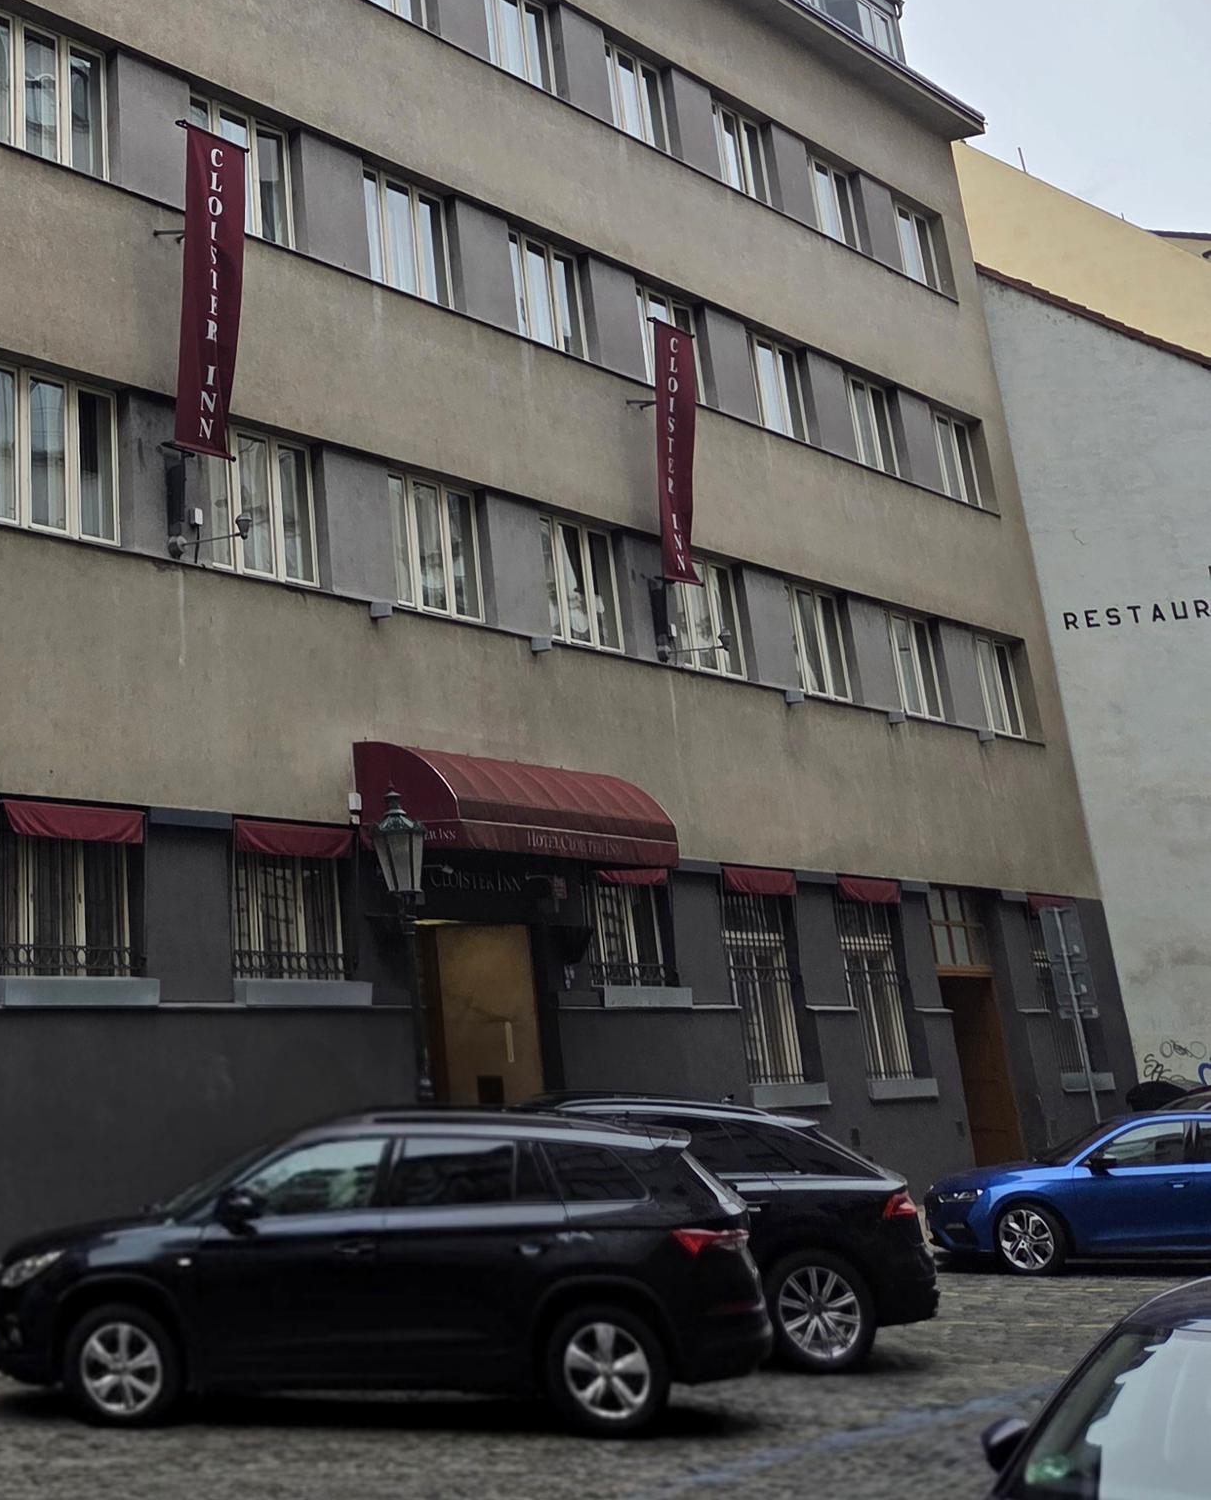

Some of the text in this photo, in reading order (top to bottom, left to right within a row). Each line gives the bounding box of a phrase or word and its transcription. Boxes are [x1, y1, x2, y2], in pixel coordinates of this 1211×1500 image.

[199, 148, 223, 441] CLOISTER INN
[667, 337, 686, 573] CLOISTER INN
[1062, 599, 1211, 631] RESTAUR
